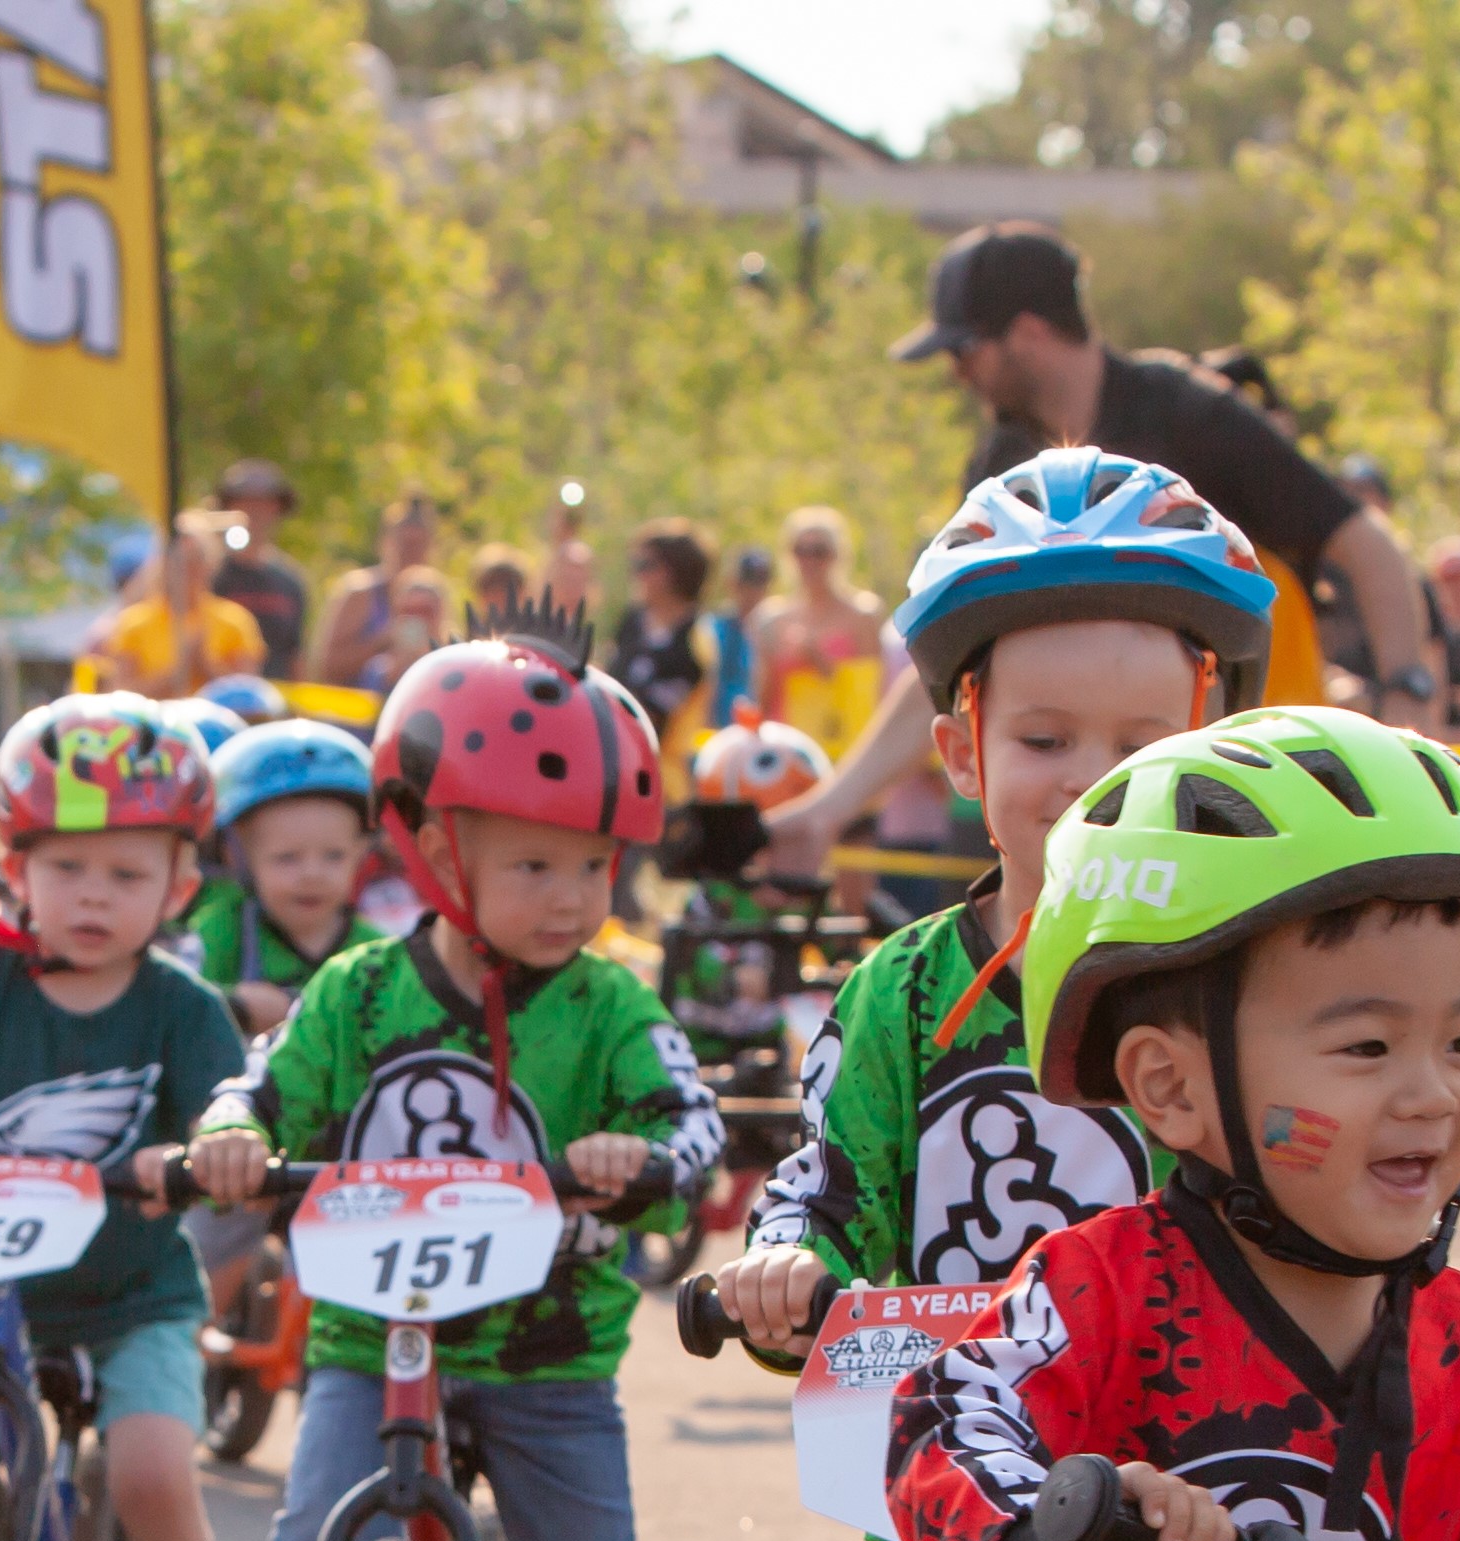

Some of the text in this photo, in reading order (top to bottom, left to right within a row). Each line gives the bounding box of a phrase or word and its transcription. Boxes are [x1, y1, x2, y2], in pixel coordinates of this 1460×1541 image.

[372, 1231, 494, 1294] 151
[882, 1292, 992, 1319] 2 YEAR
[833, 1349, 932, 1370] STRIDER
[858, 1369, 901, 1380] CUP
